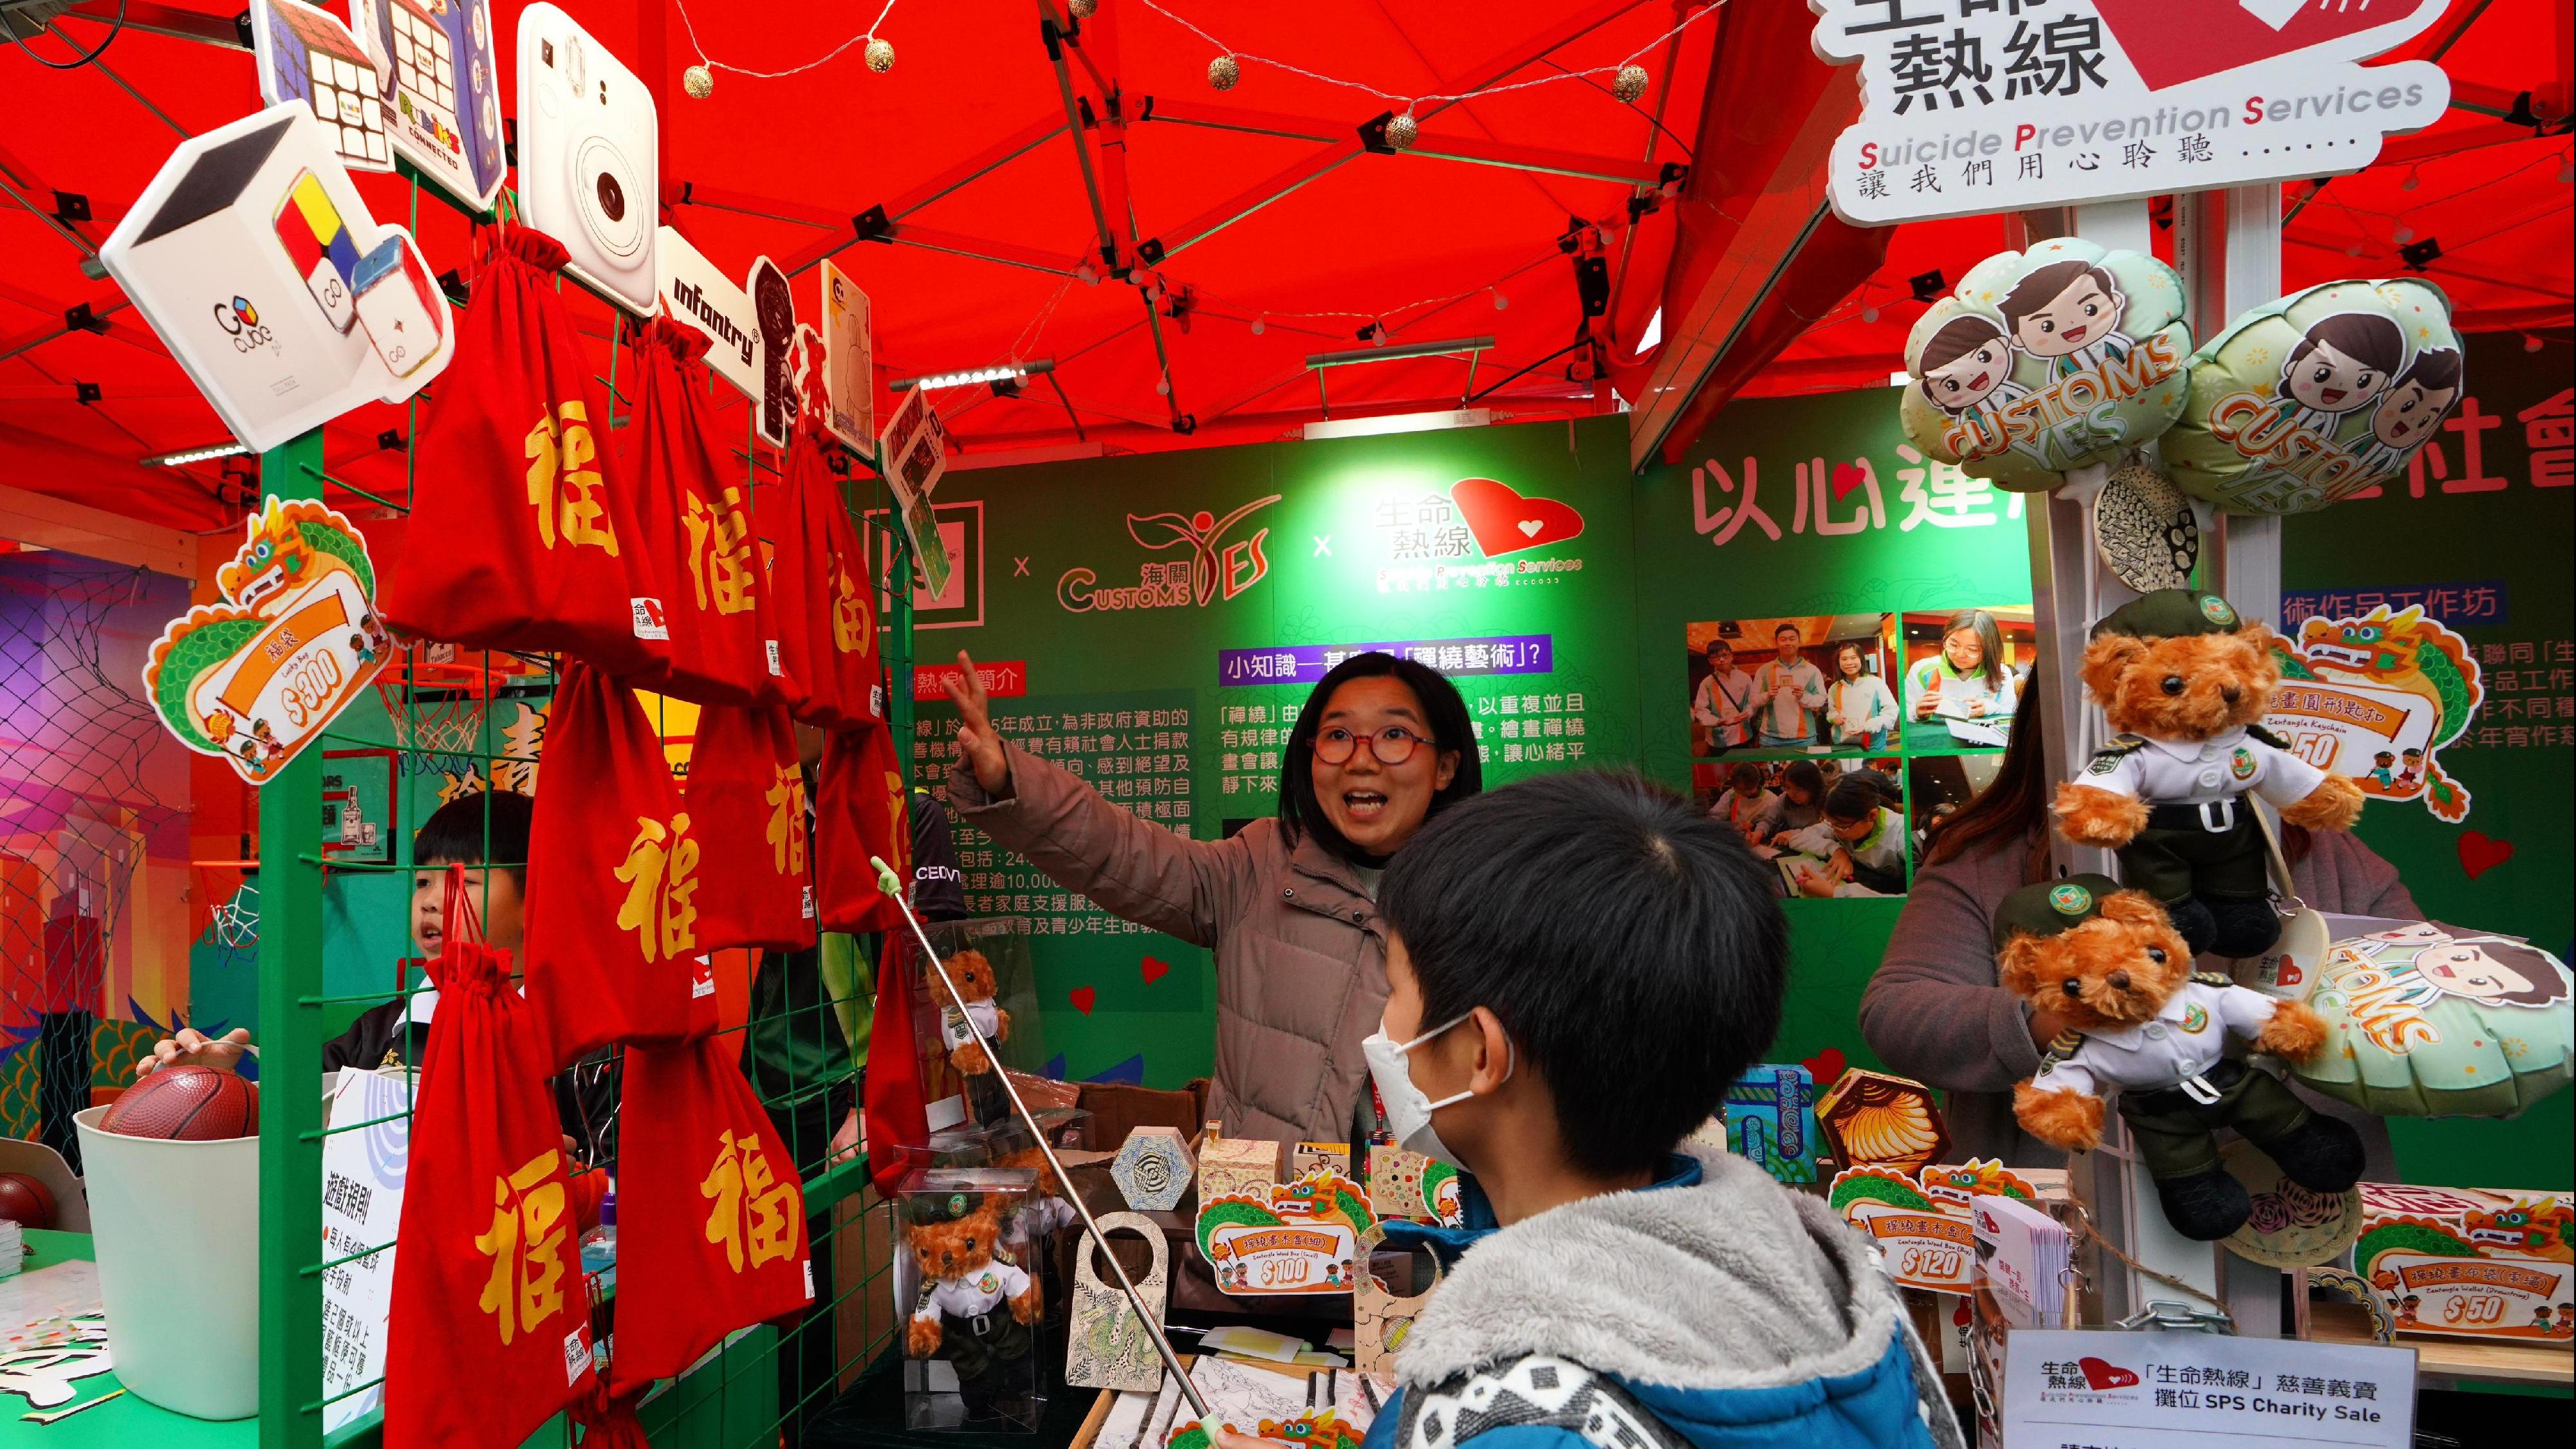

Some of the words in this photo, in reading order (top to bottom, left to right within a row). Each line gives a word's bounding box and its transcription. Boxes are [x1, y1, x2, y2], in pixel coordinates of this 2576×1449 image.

[1890, 14, 2109, 116] 熱線
[1858, 130, 2002, 170] Suicide
[2015, 105, 2230, 152] Prevention
[2243, 83, 2423, 125] Services
[408, 125, 458, 171] CONNECTED
[1941, 329, 2182, 461] CUSTOMS
[2008, 400, 2127, 472] YES
[2208, 391, 2395, 503] CUSTOM
[525, 400, 620, 558] 福
[1692, 444, 2025, 546] 以心連
[2214, 455, 2324, 515] YES
[1375, 494, 1452, 528] 生命
[680, 486, 755, 616] 福
[1393, 526, 1472, 560] 熱線
[1140, 561, 1192, 586] 海關
[1517, 558, 1582, 575] Services
[265, 628, 299, 662] 福袋
[281, 649, 342, 728] $300
[2269, 691, 2386, 723] 畫圓形匙扣
[2274, 730, 2339, 771] 50
[1085, 777, 1190, 797] 其他預防自
[1222, 775, 1278, 795] 靜下來
[613, 813, 700, 964] 福
[323, 1170, 372, 1226] 遊戲規則
[700, 1129, 799, 1274] 福
[475, 1149, 566, 1346] 福
[1902, 1248, 1963, 1280] $120
[1261, 1257, 1309, 1286] $100
[2443, 1295, 2505, 1324] $50
[2041, 1361, 2079, 1376] 生命
[2048, 1375, 2086, 1390] 熱線
[2145, 1364, 2263, 1390] 「生命熱線」
[2276, 1374, 2378, 1401] 慈善義賣
[2154, 1388, 2200, 1409] 攤位
[2205, 1394, 2246, 1411] SPS
[2252, 1398, 2328, 1421] Charity
[2334, 1407, 2382, 1423] Sale
